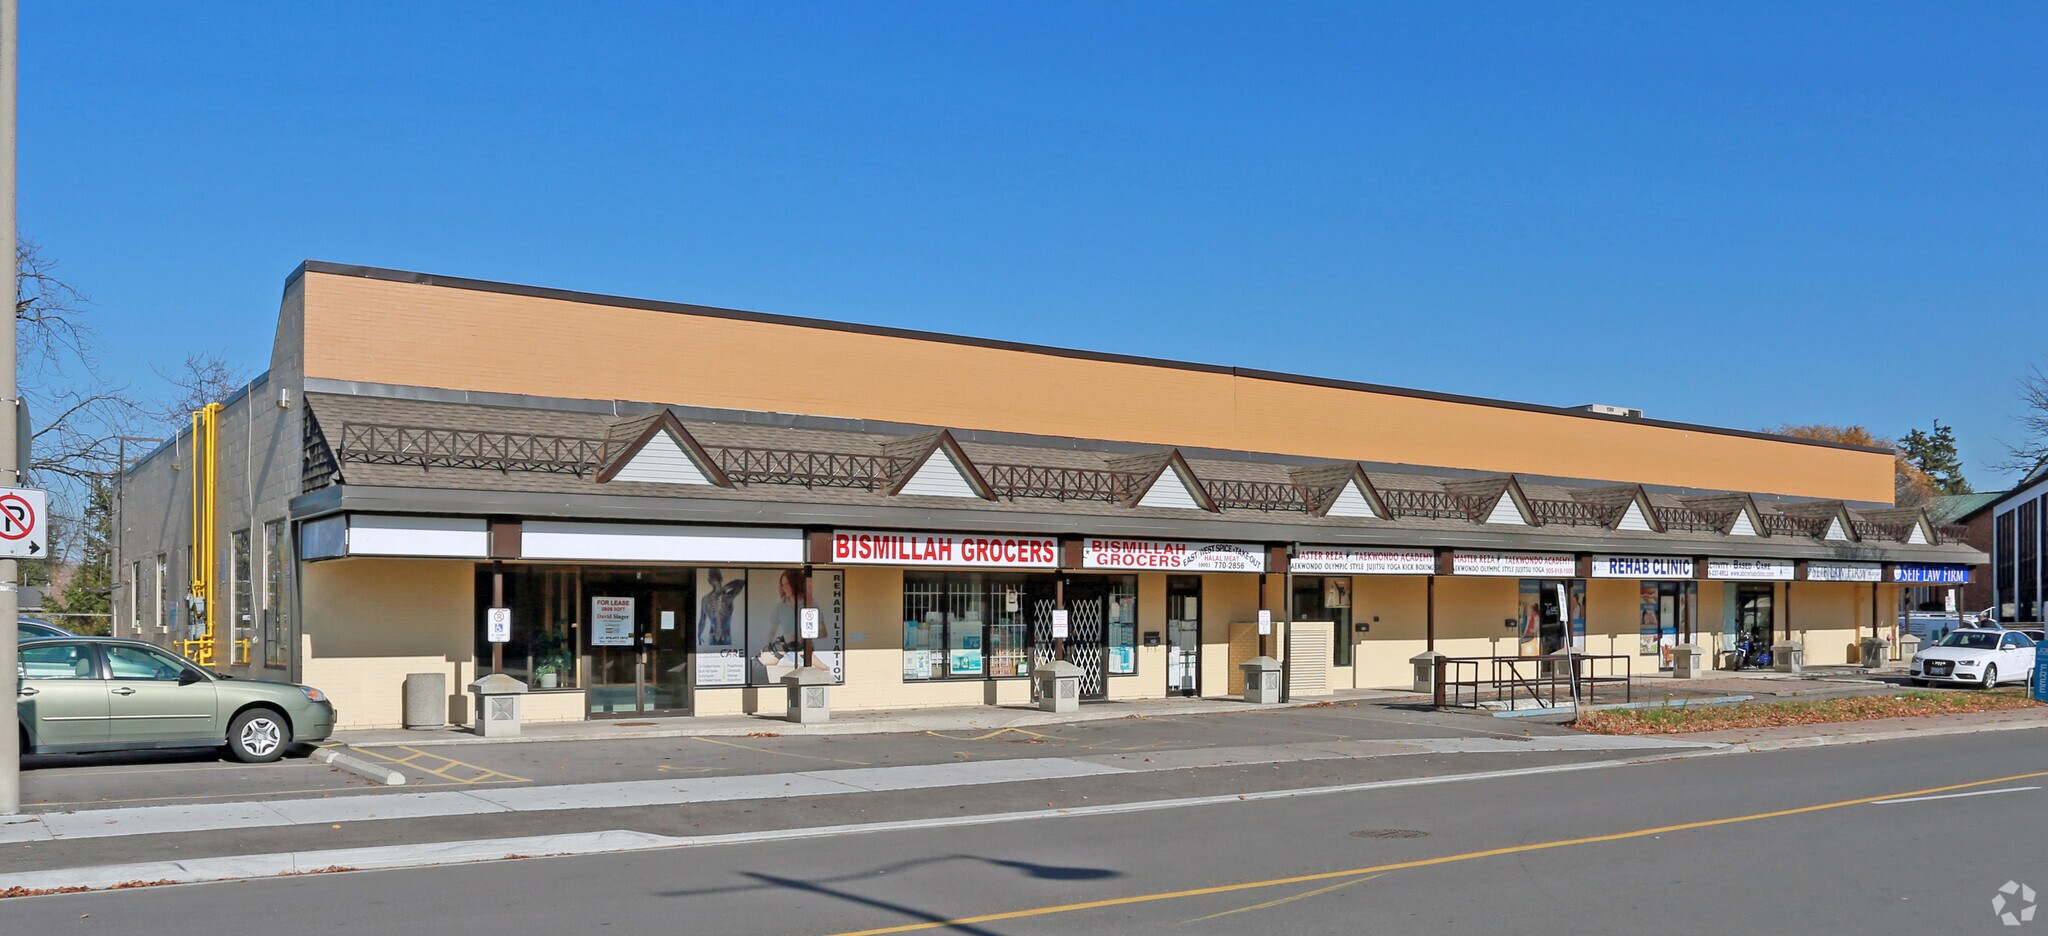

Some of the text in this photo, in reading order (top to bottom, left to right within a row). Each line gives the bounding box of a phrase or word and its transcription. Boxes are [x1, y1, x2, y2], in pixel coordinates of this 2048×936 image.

[836, 534, 1054, 564] BISMILLAH GROCERS
[1091, 540, 1186, 555] BISMILLAH
[1215, 544, 1232, 552] SPICE
[1096, 553, 1181, 567] GROCERS
[1326, 551, 1344, 560] REZA
[1354, 552, 1399, 561] TAEKWONDO
[1400, 552, 1434, 562] ACADEMY
[1454, 554, 1570, 565] MASTER REZA TAEKWONDO ACADEMY
[1366, 563, 1385, 571] JUJITSU
[1609, 557, 1690, 575] REHAB CLINIC
[1708, 561, 1729, 569] CTIVITY
[1902, 565, 1963, 582] SEIF LAW FIRM
[833, 574, 842, 683] REHABILITATION
[720, 649, 744, 657] CARE
